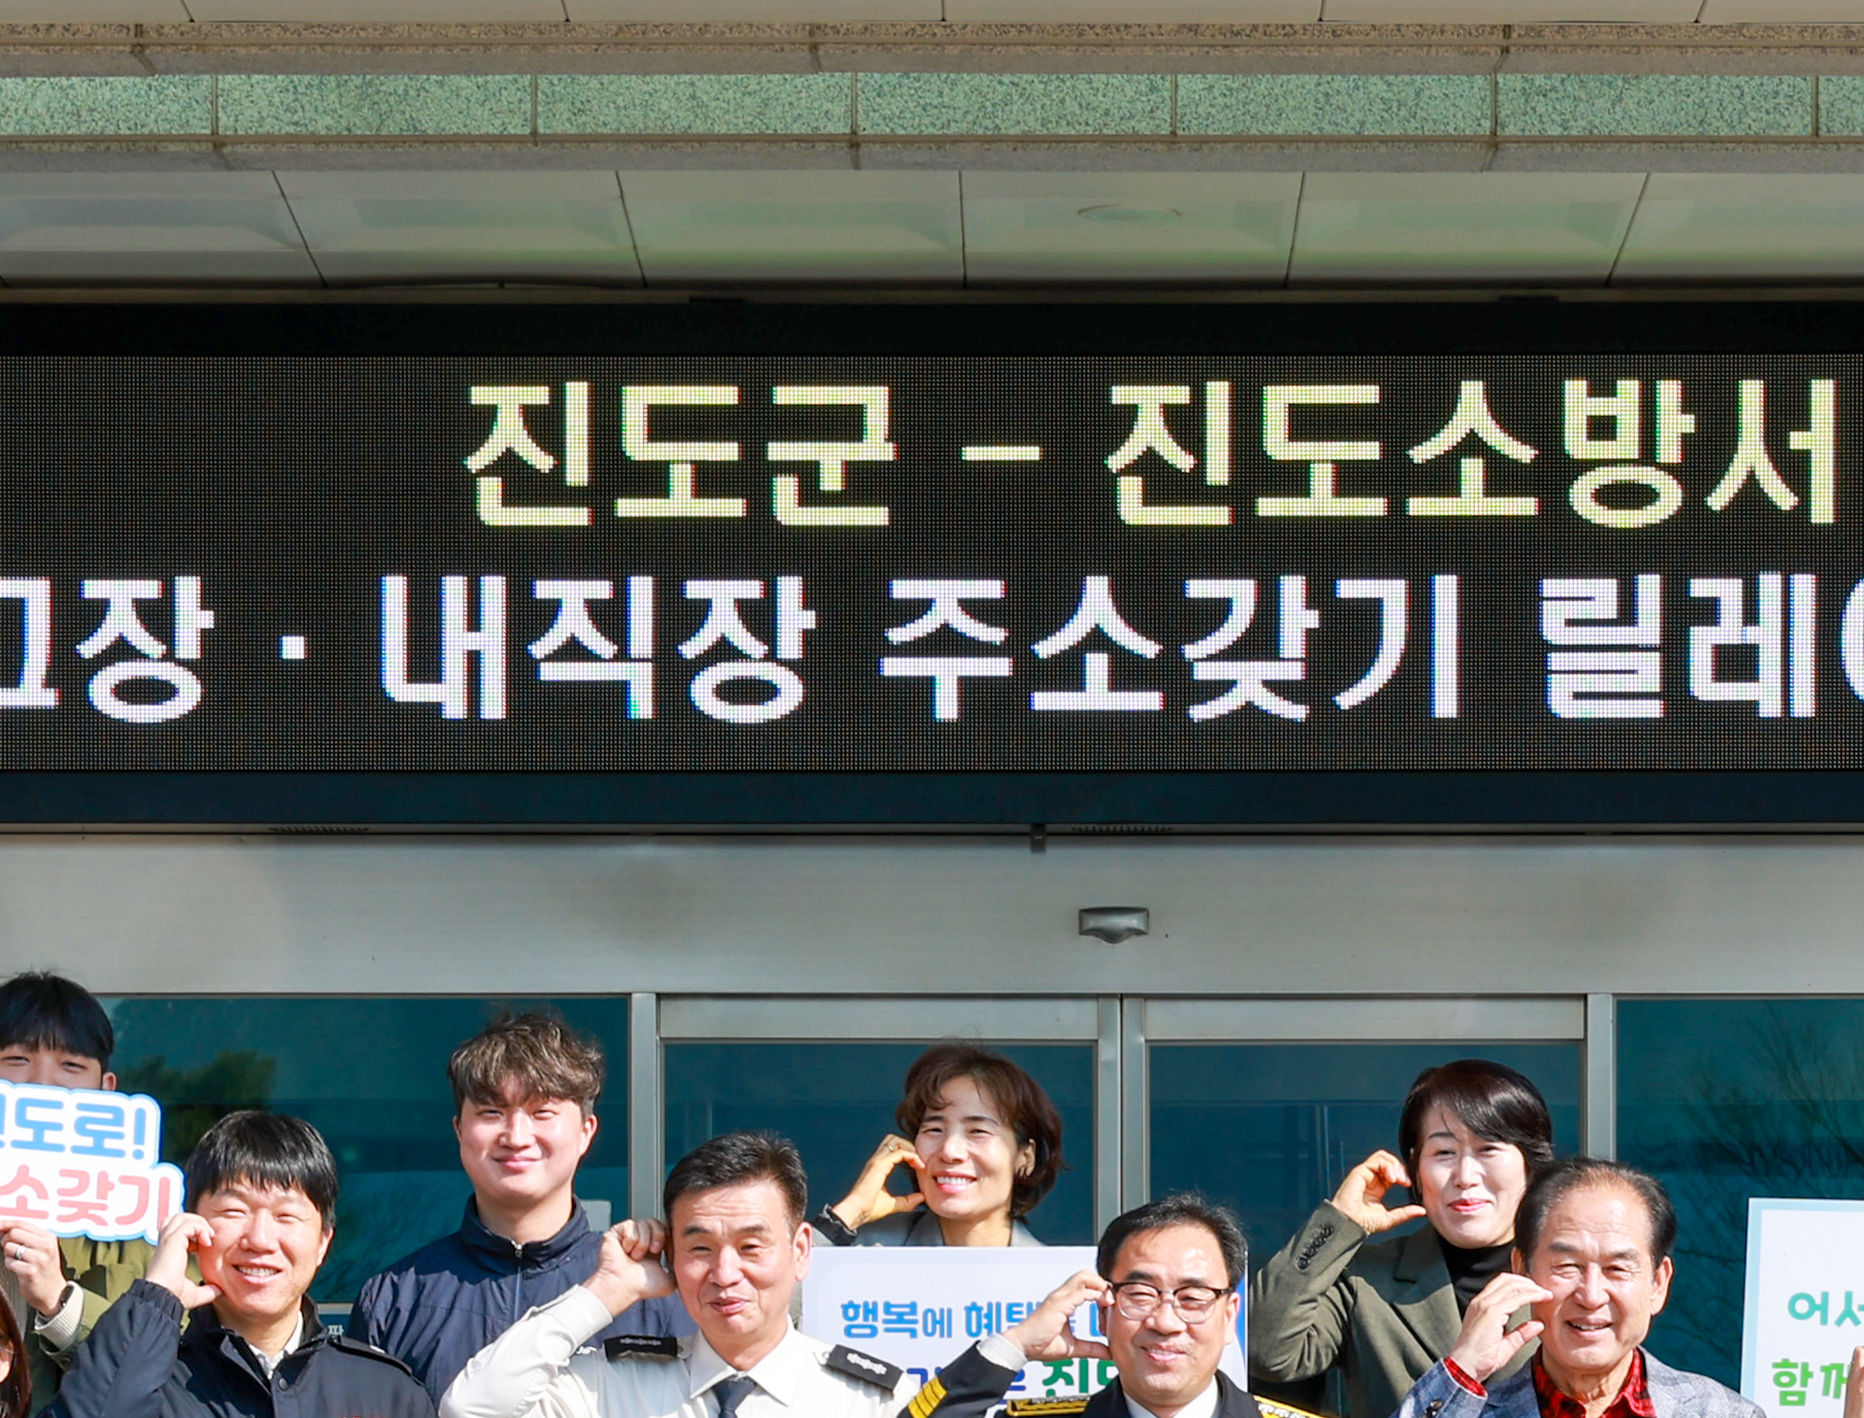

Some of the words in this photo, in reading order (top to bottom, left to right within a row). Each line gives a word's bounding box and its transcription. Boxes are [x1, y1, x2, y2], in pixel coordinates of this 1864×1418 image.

[465, 380, 895, 527] 진도군
[1107, 379, 1836, 529] 진도소방서
[380, 574, 817, 724] 내직장
[878, 573, 1459, 724] 주소갖기
[840, 1300, 953, 1339] 행복에
